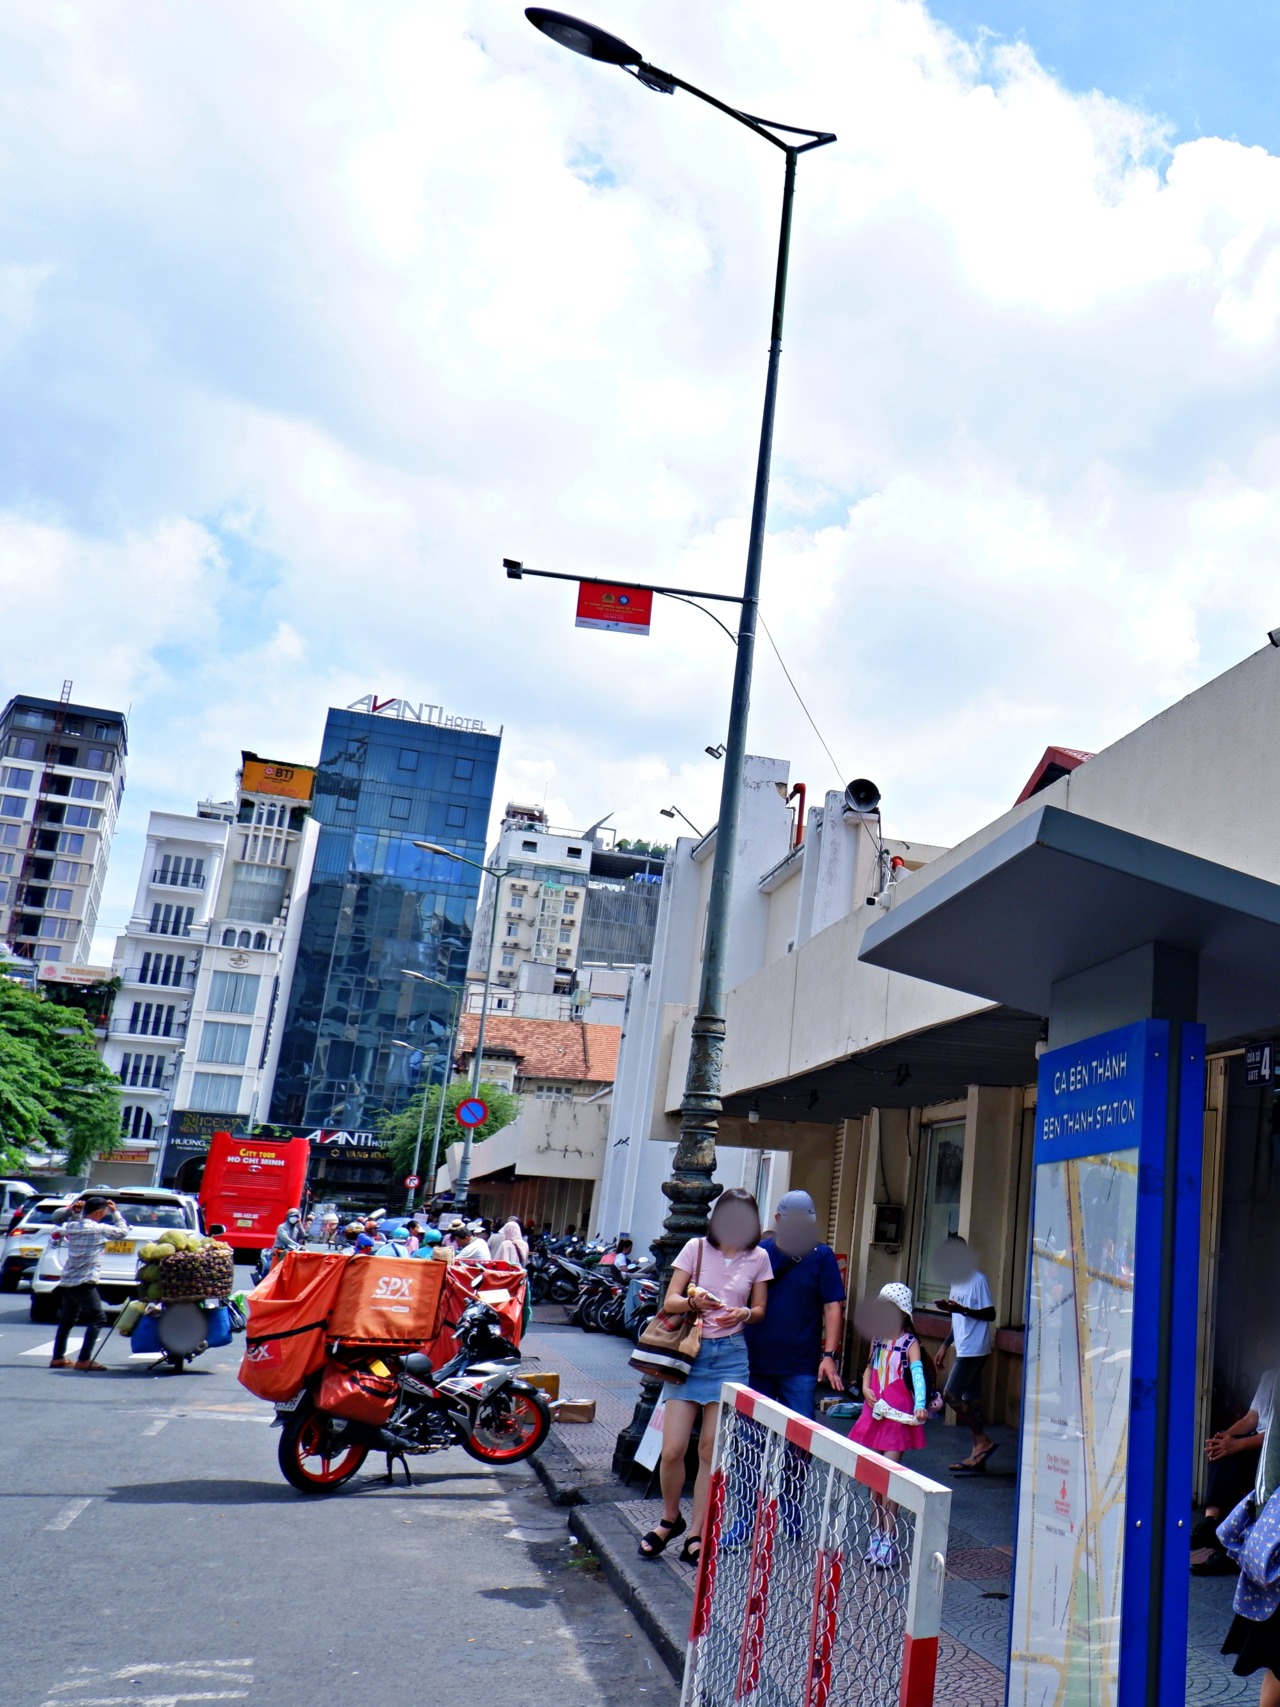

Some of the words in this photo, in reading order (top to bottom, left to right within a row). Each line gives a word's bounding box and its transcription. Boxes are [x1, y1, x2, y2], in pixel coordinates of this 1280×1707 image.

[346, 694, 444, 724] AVANTI
[445, 715, 487, 732] HOTEL
[1054, 1072, 1067, 1095] GA
[1069, 1057, 1089, 1092] BẾN
[1091, 1051, 1128, 1083] THÀNH
[1260, 1046, 1271, 1080] 4
[1043, 1115, 1061, 1140] BEN
[1062, 1110, 1094, 1136] THANH
[1096, 1098, 1136, 1130] STATION
[305, 1129, 372, 1146] AVANTI
[259, 1151, 276, 1159] TOUR
[260, 1158, 285, 1167] MINH
[375, 1276, 415, 1298] SPX
